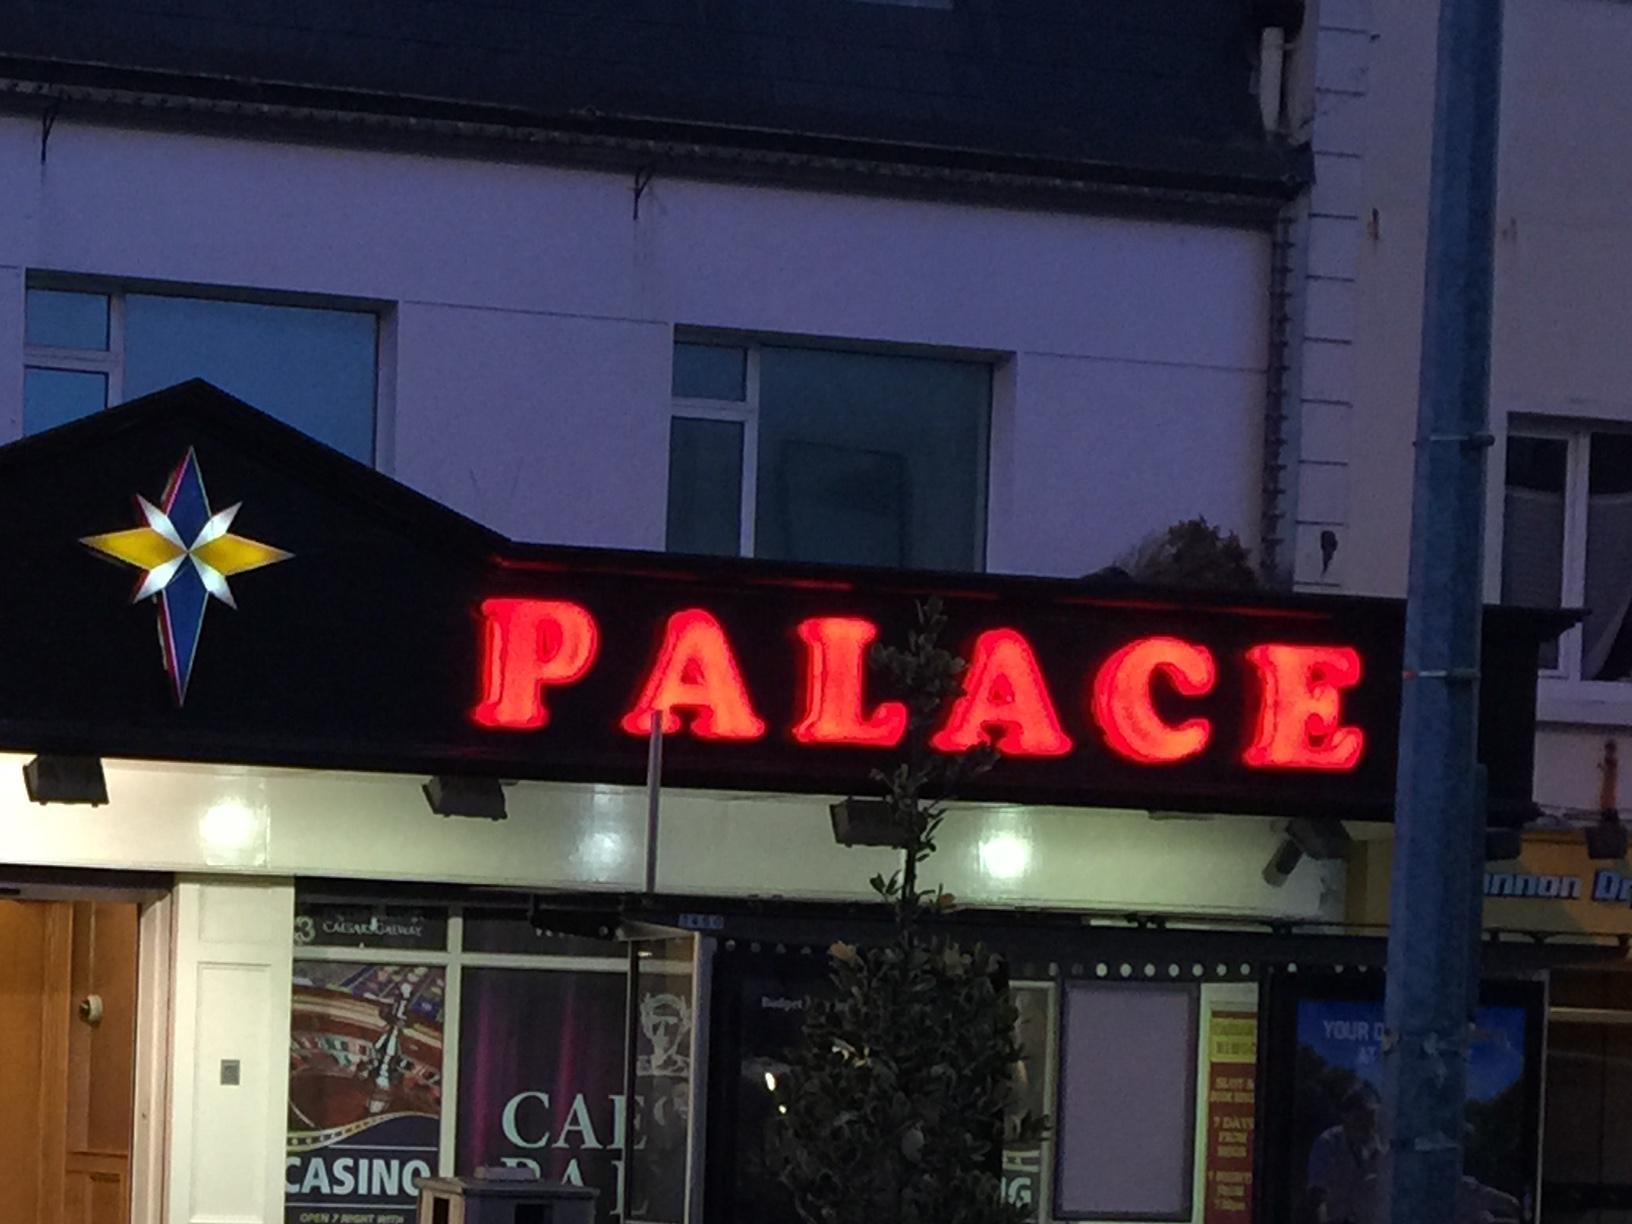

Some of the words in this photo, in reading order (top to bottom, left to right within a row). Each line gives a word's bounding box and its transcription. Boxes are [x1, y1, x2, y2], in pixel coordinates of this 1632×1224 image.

[469, 597, 1366, 771] PALACE
[1323, 1020, 1369, 1039] YOUR
[285, 1156, 431, 1196] CASINO
